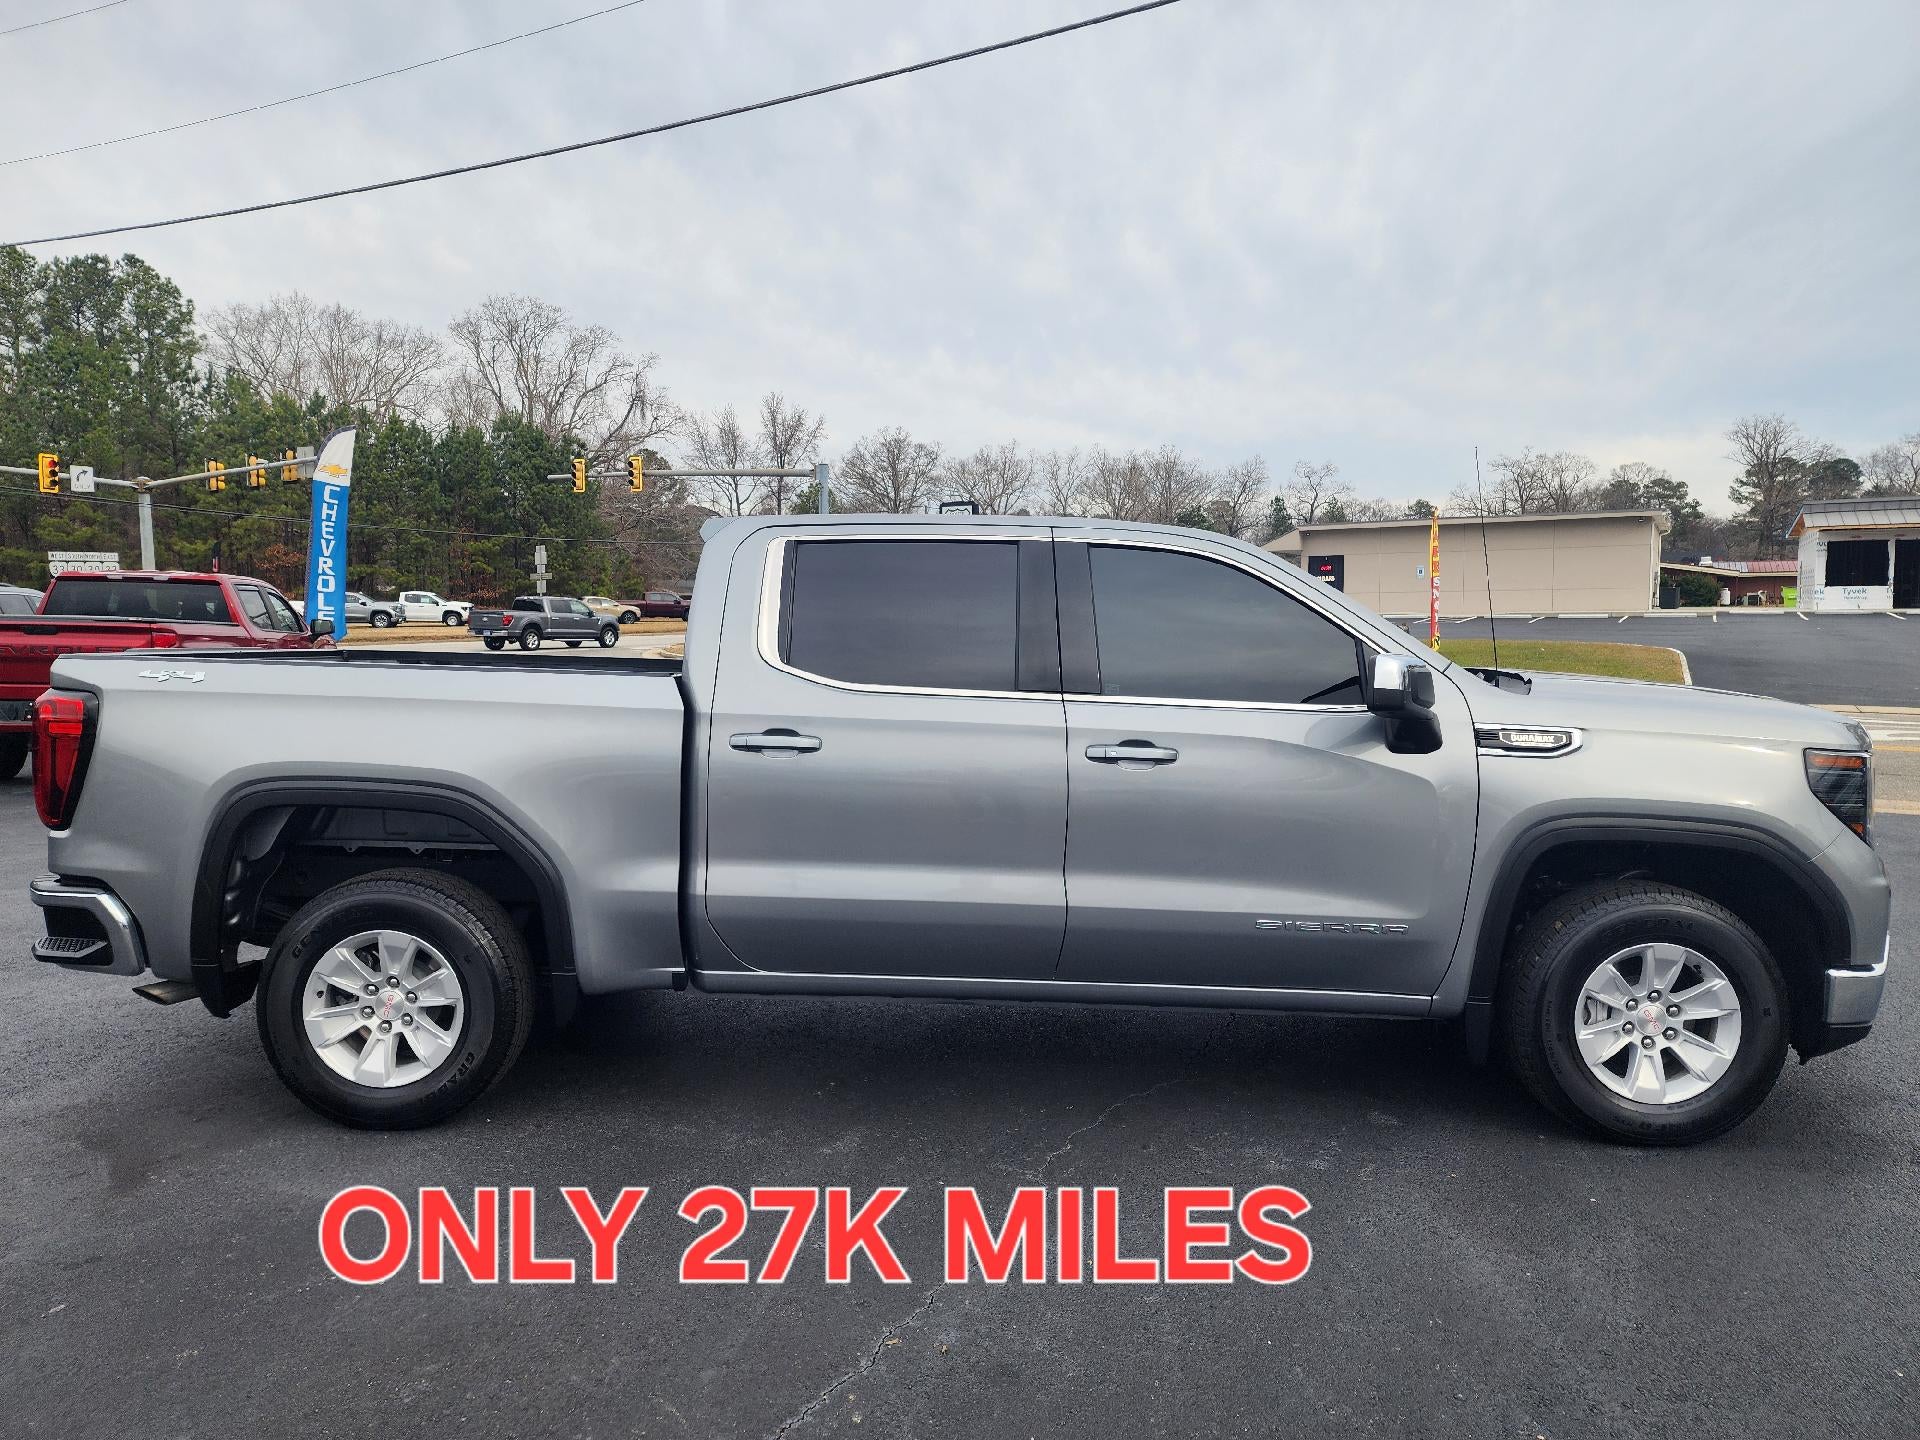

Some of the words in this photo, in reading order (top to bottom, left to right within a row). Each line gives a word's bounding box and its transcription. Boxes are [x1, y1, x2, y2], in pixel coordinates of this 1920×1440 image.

[316, 485, 341, 622] CHEVROLE
[1842, 587, 1867, 596] Tyvek
[1510, 733, 1555, 743] DURAMAX
[1255, 919, 1409, 936] SIERRA
[384, 994, 394, 1018] GMC
[1643, 1009, 1660, 1031] GMC
